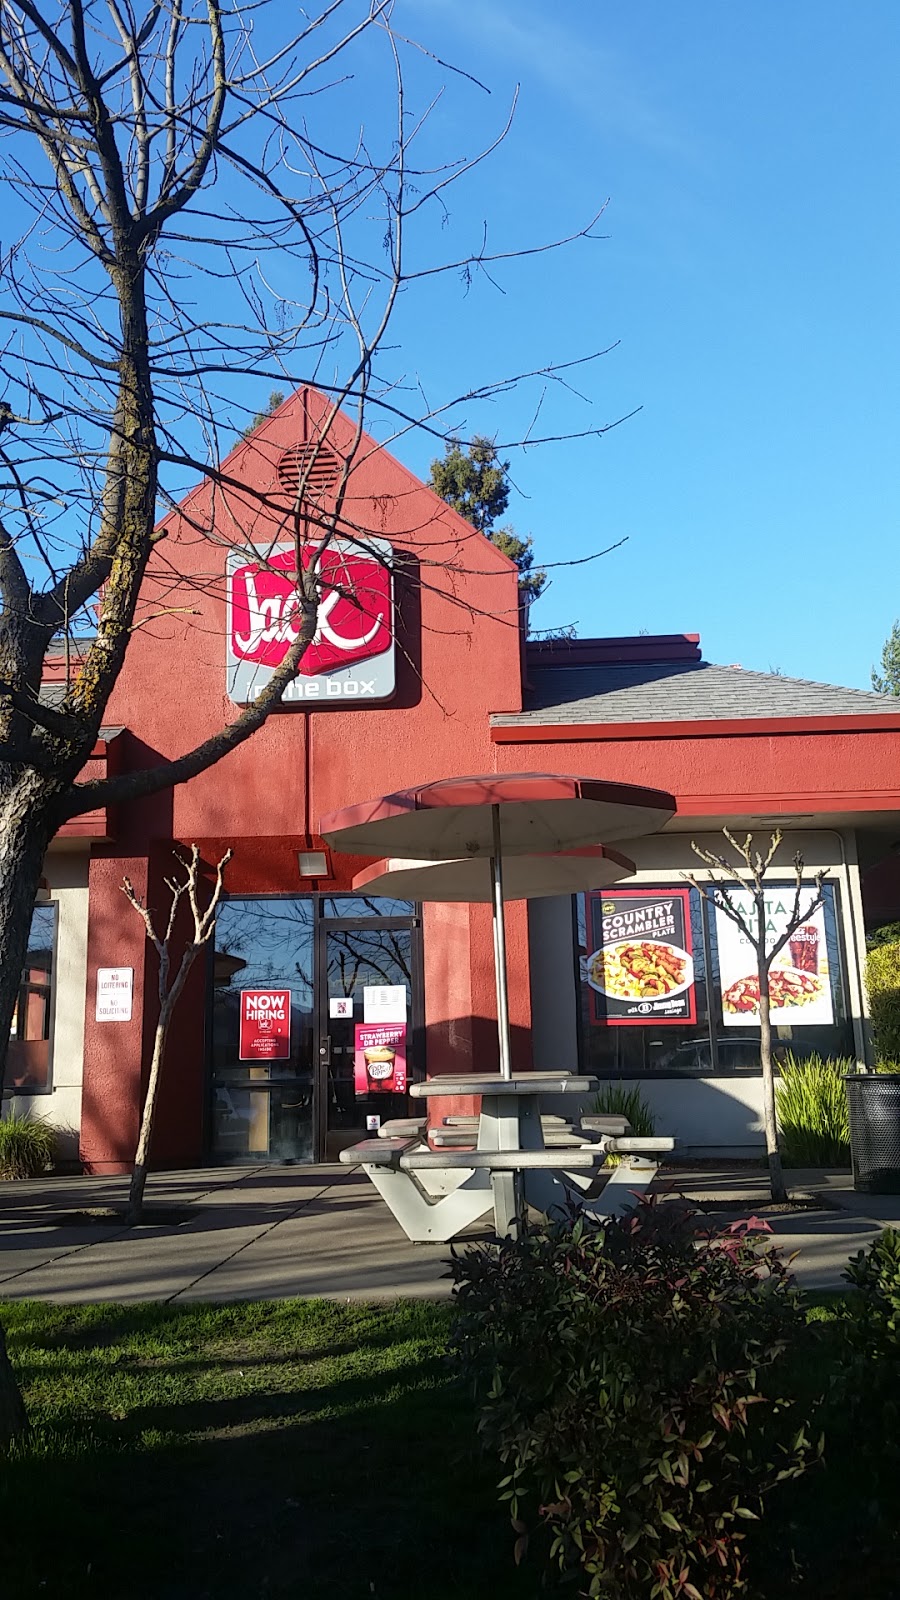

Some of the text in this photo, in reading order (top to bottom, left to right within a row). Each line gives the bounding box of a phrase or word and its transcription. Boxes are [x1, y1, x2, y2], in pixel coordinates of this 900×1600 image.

[281, 680, 319, 699] he
[326, 678, 375, 696] box
[602, 902, 673, 930] COUNTRY
[602, 915, 675, 941] SCRAMBLER
[652, 927, 676, 938] PLATE
[101, 981, 129, 989] LOITERING
[246, 995, 285, 1010] NOW
[246, 1009, 285, 1021] HIRING
[359, 1030, 404, 1041] STRAWBERRY
[374, 1037, 400, 1046] PEPPER
